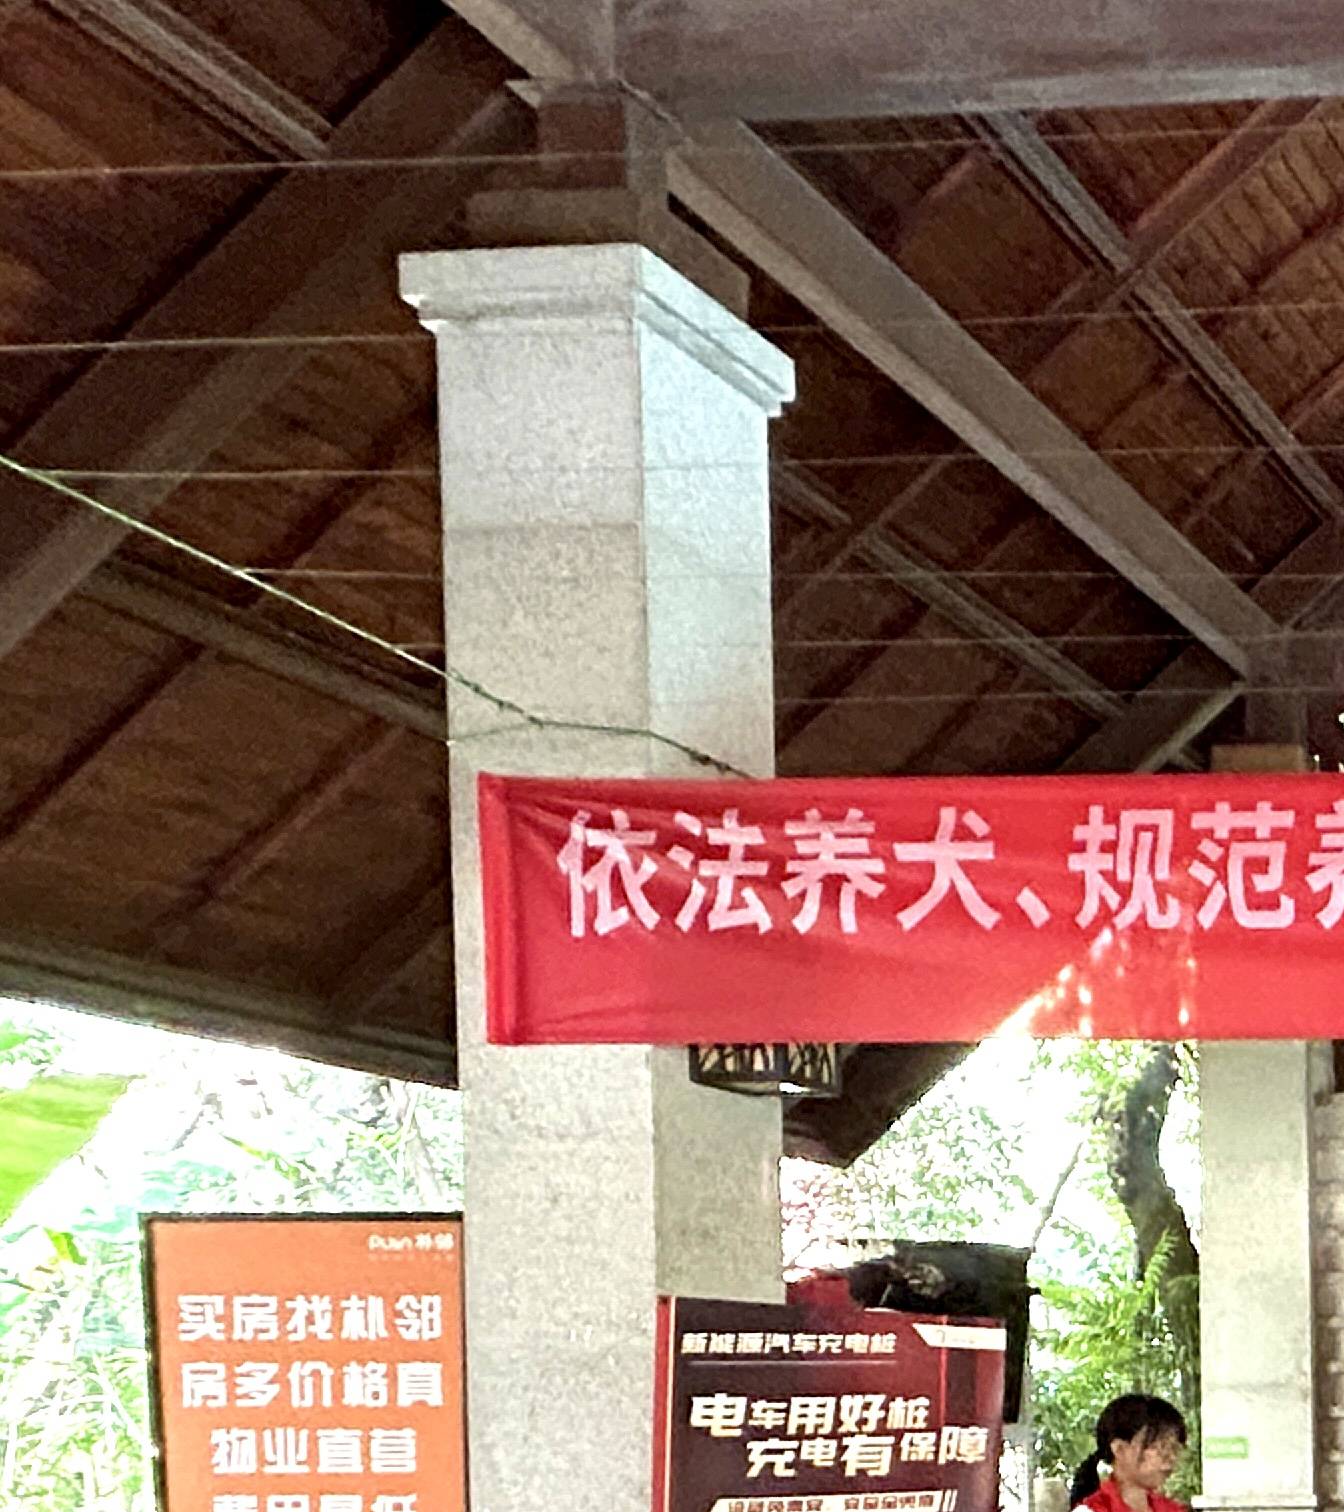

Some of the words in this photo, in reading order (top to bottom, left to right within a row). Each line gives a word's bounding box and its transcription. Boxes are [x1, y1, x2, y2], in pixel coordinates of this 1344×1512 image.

[177, 1295, 442, 1342] 买房找朴邻
[681, 1333, 897, 1354] 新能源汽车充电桩
[182, 1362, 444, 1408] 房多价格真
[690, 1393, 930, 1438] 电车用好桩
[211, 1428, 417, 1475] 物业直营
[746, 1426, 989, 1478] 充电有保障
